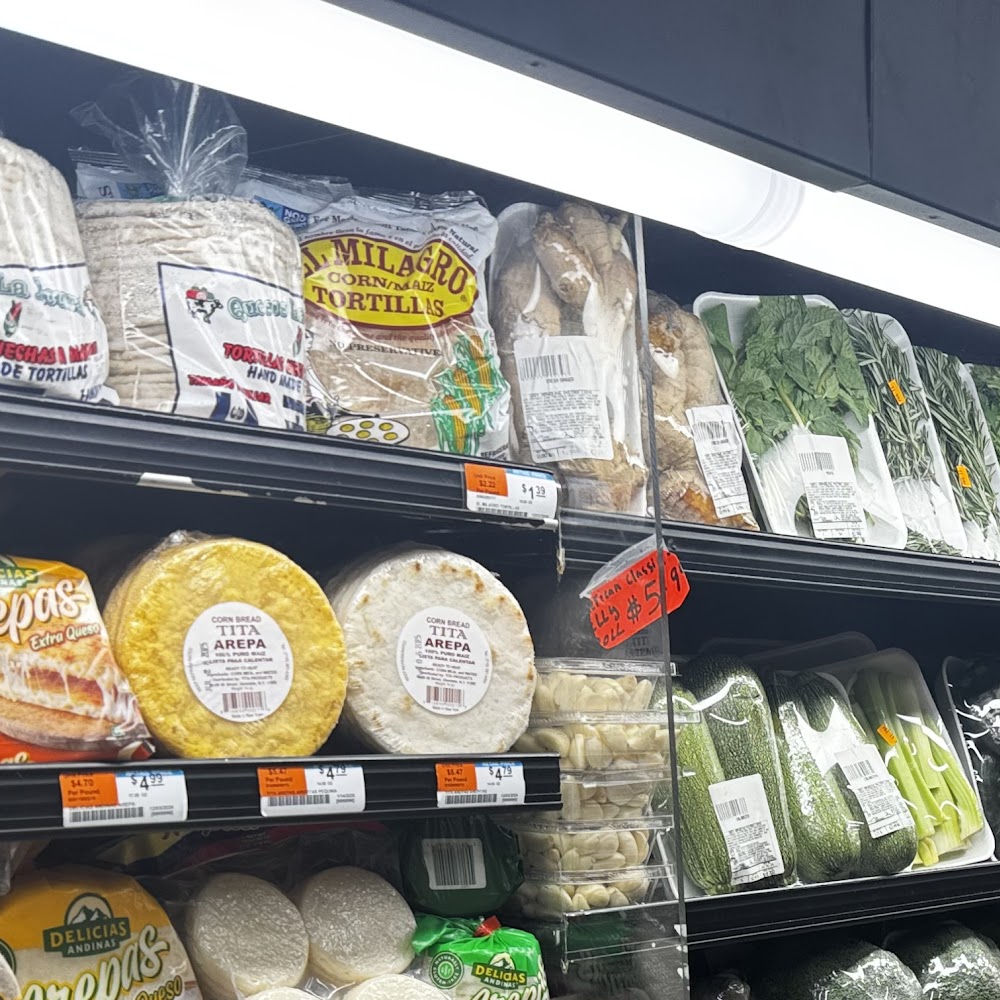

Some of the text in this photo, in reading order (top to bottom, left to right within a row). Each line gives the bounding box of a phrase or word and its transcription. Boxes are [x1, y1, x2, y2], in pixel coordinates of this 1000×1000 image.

[330, 238, 468, 295] MILAGRO
[327, 271, 435, 293] CORN/MAIZ
[312, 286, 445, 318] TORTILLAS
[1, 361, 88, 382] DE TORTILLAS
[211, 616, 233, 624] CORN
[426, 616, 470, 629] CORN BREAD
[29, 623, 100, 652] Extra Queso
[216, 624, 261, 636] TITA
[429, 625, 468, 640] TITA
[214, 638, 267, 650] AREPA
[424, 638, 471, 653] AREPA
[51, 920, 129, 949] DELICIAS
[67, 938, 117, 956] ANDINAS
